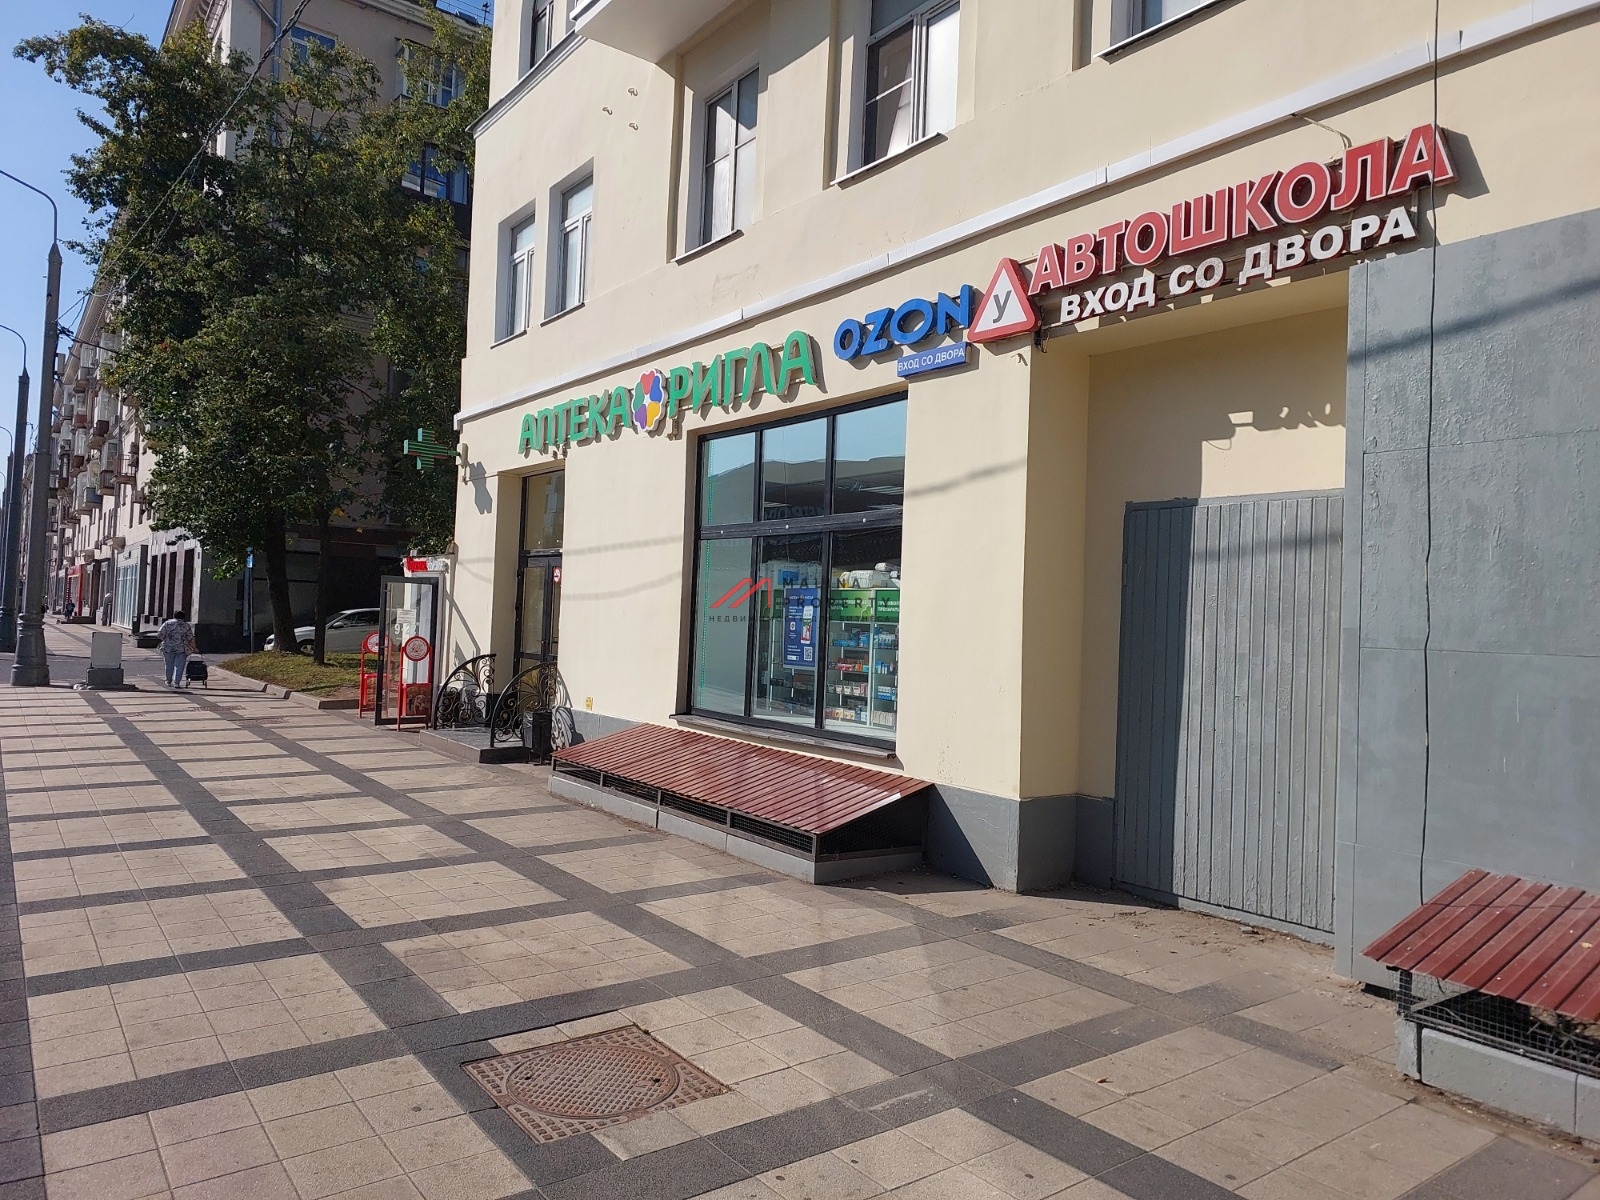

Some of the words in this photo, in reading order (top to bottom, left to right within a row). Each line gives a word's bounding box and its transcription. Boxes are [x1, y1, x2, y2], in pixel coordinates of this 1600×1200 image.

[1028, 122, 1454, 296] АВТОШКОЛА
[1060, 273, 1157, 323] ВХОД
[1168, 257, 1225, 296] СО
[1238, 205, 1417, 286] ДВОРА
[833, 283, 974, 361] OZON
[898, 358, 919, 372] ВХОД
[921, 354, 933, 366] СО
[934, 347, 965, 365] ДВОРА
[518, 385, 631, 455] АПТЕКА
[668, 330, 819, 419] РИГЛА
